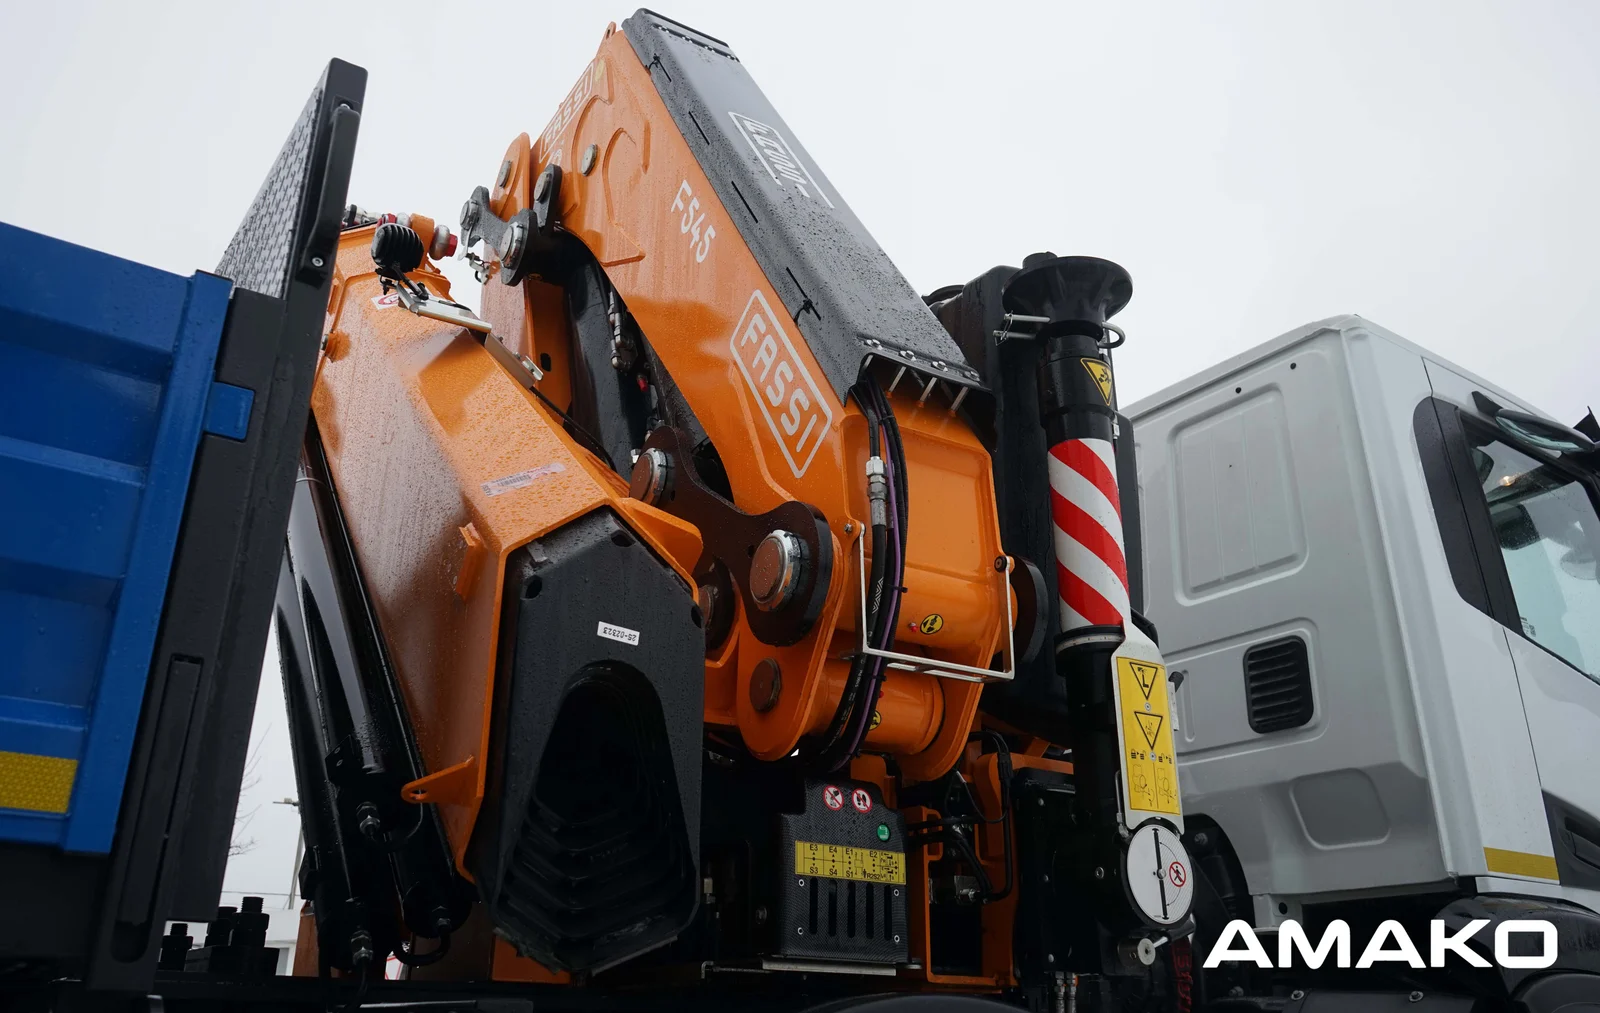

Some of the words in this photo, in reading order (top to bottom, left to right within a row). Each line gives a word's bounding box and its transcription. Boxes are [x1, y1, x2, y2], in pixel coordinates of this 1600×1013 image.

[543, 75, 589, 152] FASSI
[671, 180, 716, 263] F545
[741, 313, 818, 453] FASSI
[602, 626, 637, 642] 25-02323
[809, 844, 819, 852] E3
[828, 846, 838, 854] E4
[845, 848, 854, 856] E1
[869, 850, 878, 859] E2
[809, 866, 819, 875] S3
[829, 868, 838, 877] S4
[845, 870, 854, 878] S1
